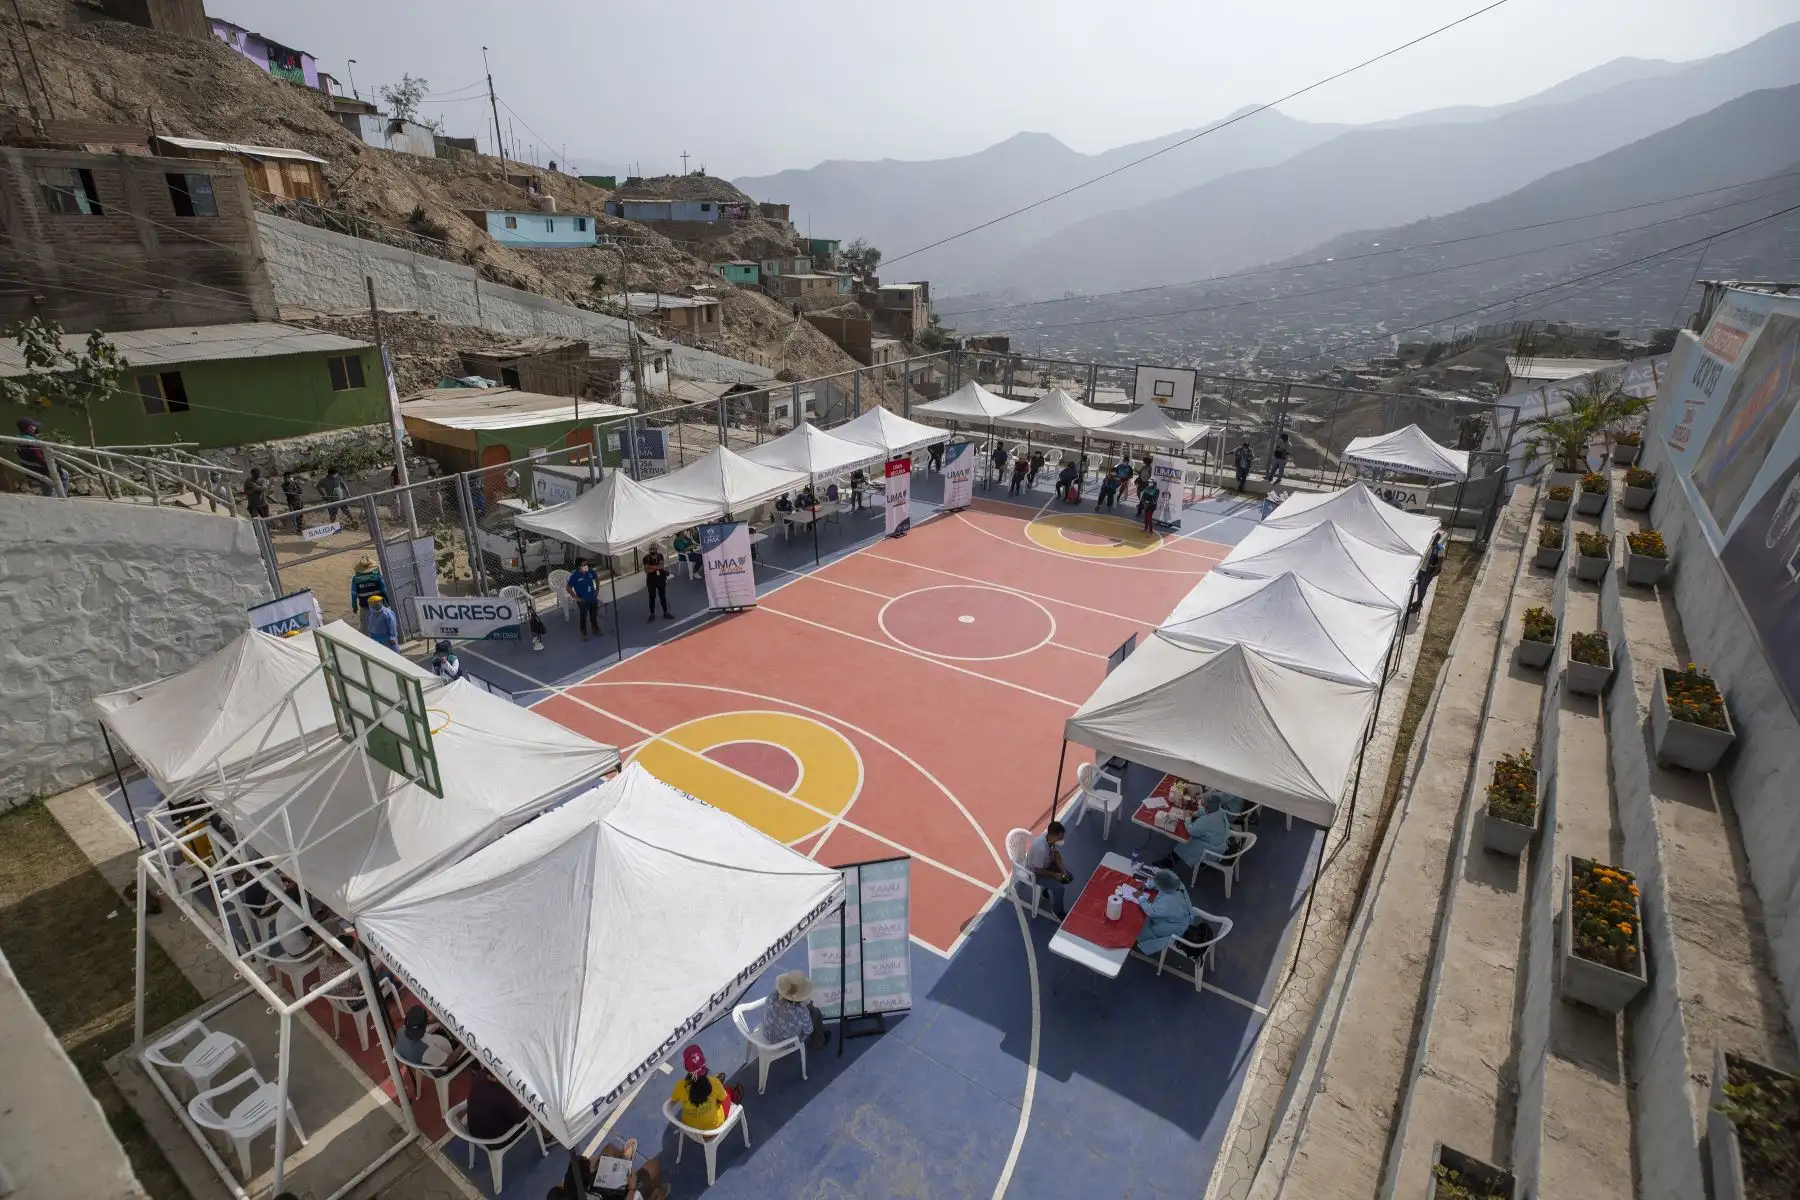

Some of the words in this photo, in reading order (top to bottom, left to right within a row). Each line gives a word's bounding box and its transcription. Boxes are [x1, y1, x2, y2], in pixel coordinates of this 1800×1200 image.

[1348, 454, 1390, 467] Partnership
[946, 469, 965, 480] LIMA
[1155, 466, 1176, 477] LIMA
[886, 490, 904, 503] LIMA
[1367, 486, 1417, 505] AIDA
[308, 525, 336, 537] SALIDA
[708, 559, 738, 570] LIMA
[422, 604, 513, 620] INGRESO
[591, 1011, 704, 1117] Partnership
[708, 982, 732, 1012] for
[737, 932, 794, 986] Healthy
[797, 895, 834, 932] Cities
